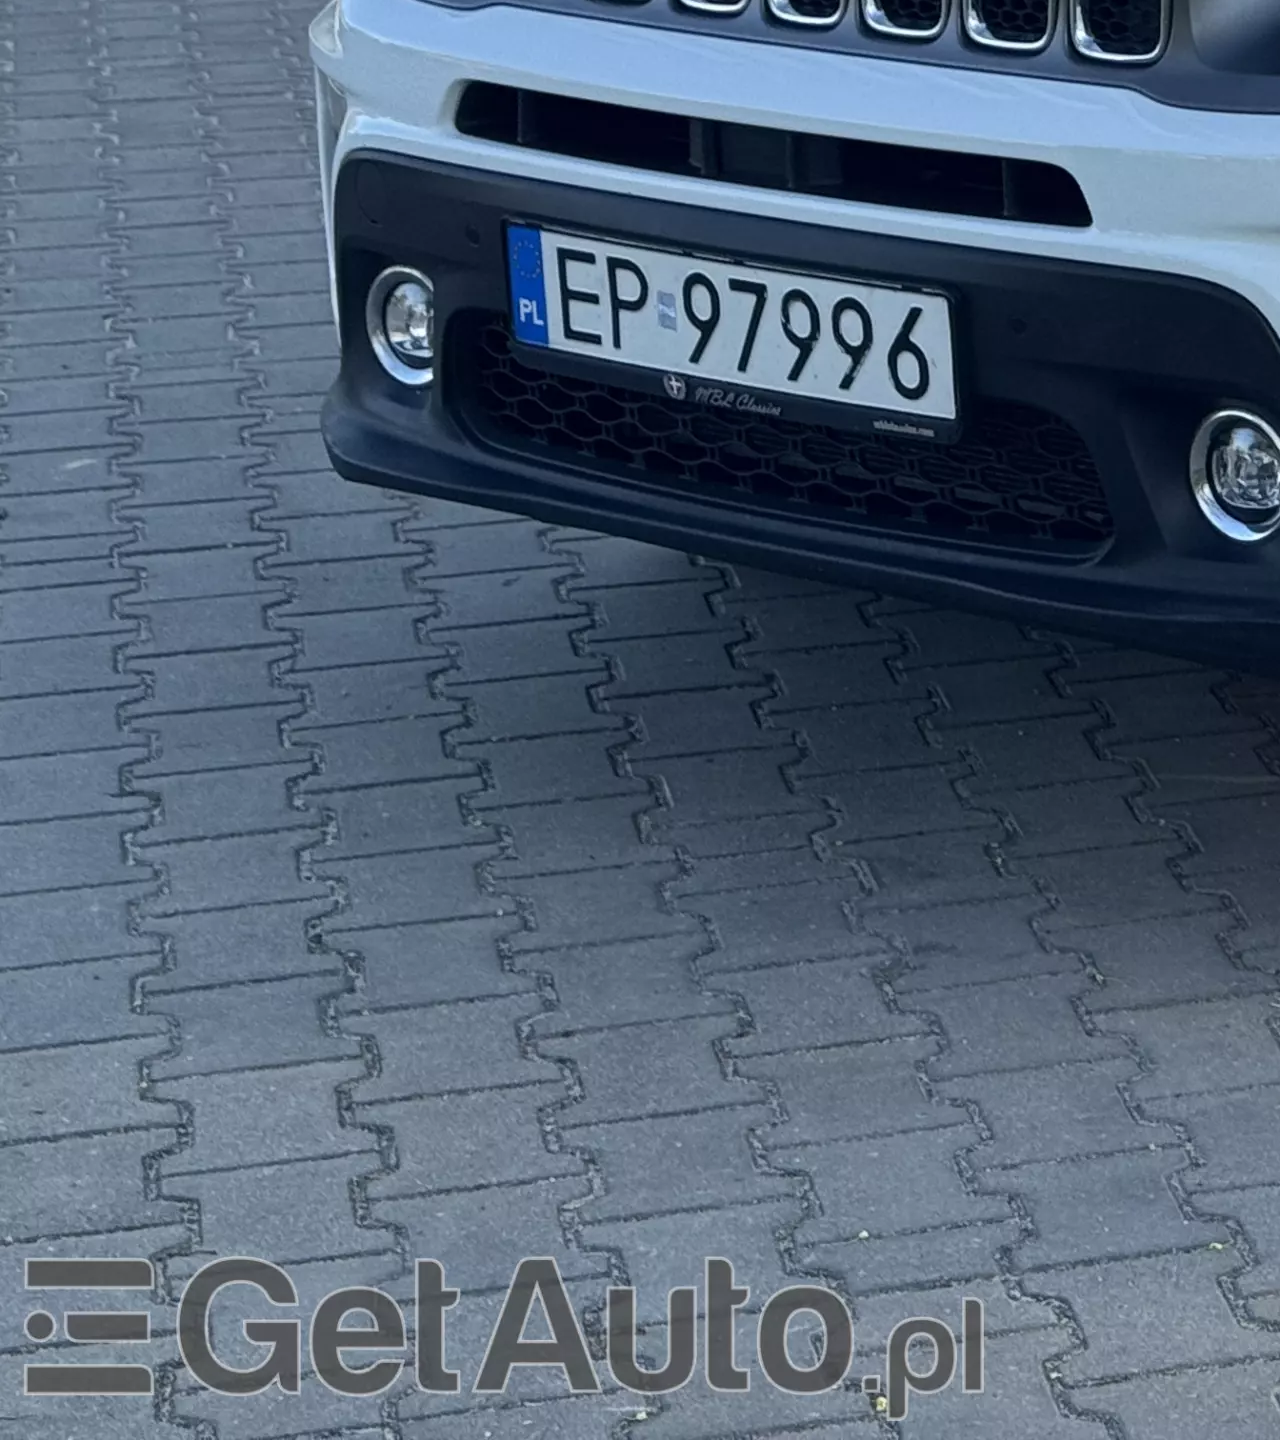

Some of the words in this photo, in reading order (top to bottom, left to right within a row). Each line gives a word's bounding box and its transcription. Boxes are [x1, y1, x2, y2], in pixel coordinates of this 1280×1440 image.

[518, 297, 545, 327] PL
[556, 246, 649, 350] EP
[682, 271, 930, 401] 97996
